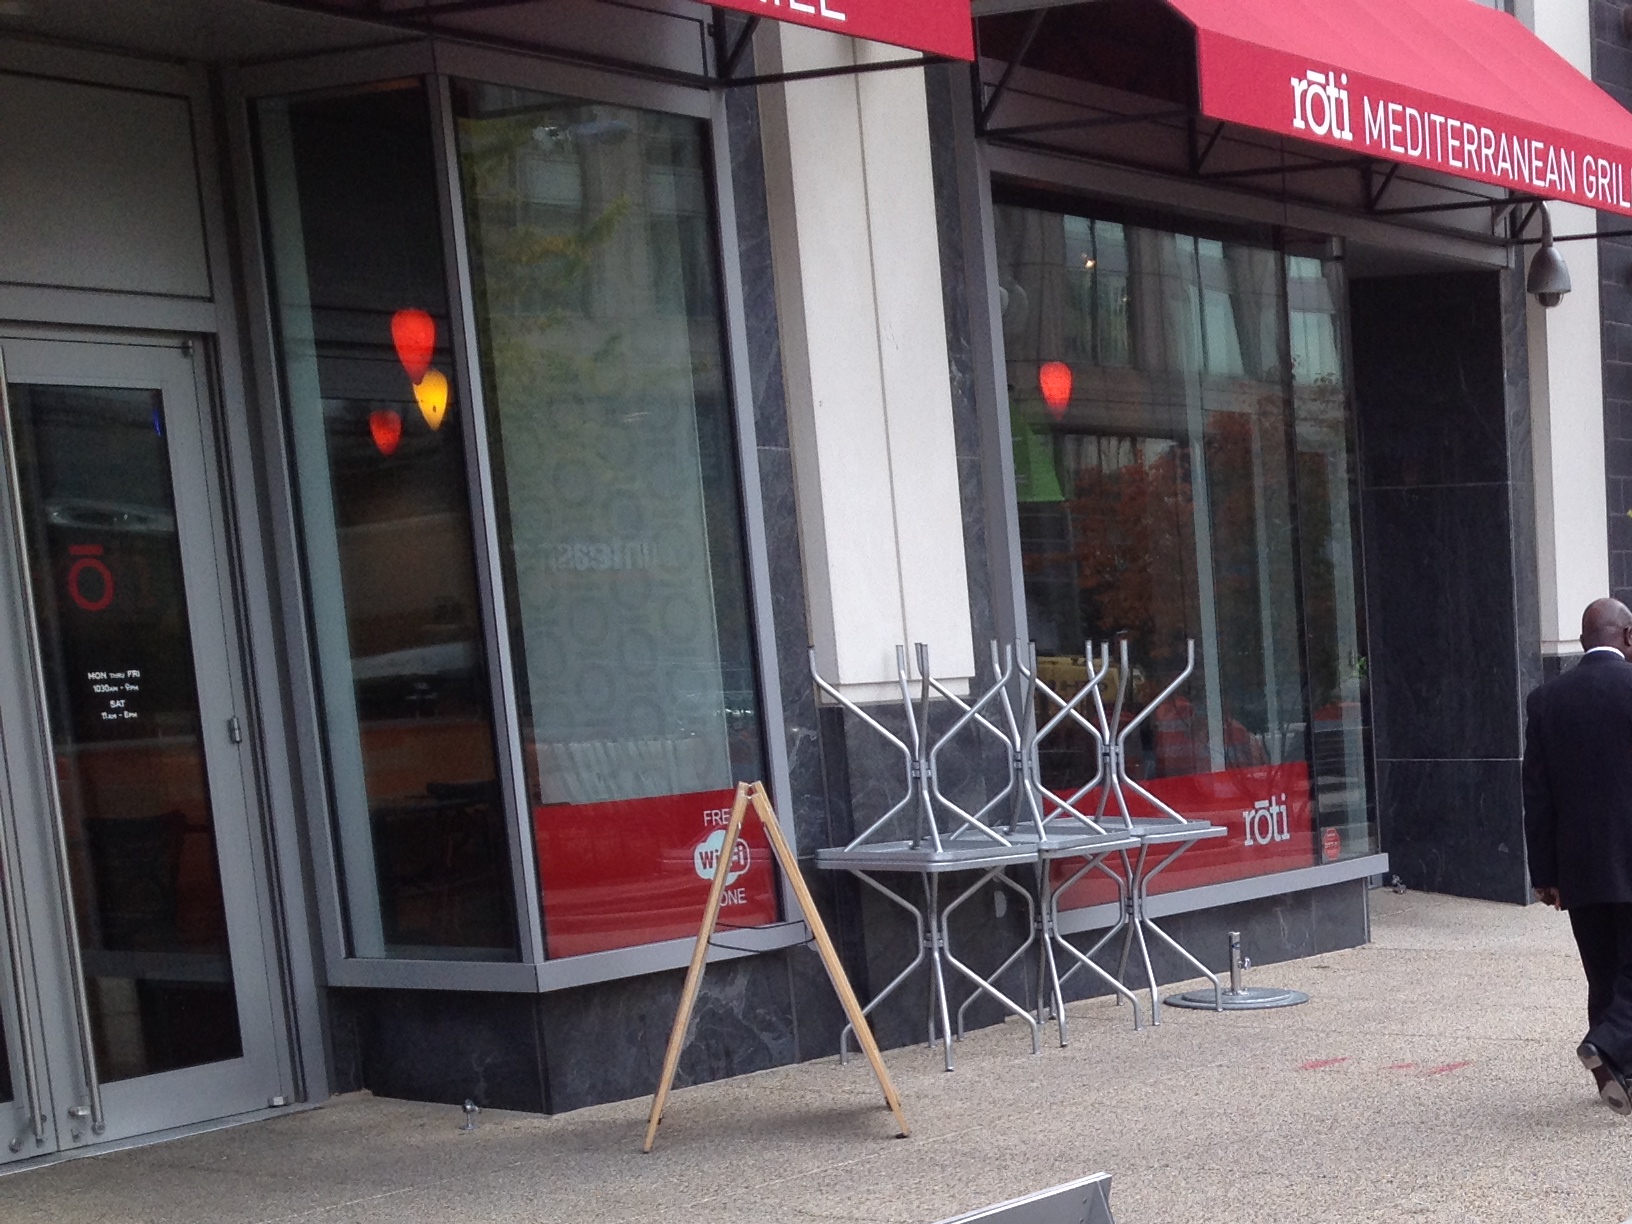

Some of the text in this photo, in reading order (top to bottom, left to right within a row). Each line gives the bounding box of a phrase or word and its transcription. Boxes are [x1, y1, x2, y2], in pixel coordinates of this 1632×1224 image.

[1363, 95, 1577, 194] MEDITERRANEAN
[88, 671, 107, 679] MON
[127, 670, 140, 678] FRI
[109, 699, 126, 708] SAT
[703, 808, 731, 826] FRE
[720, 888, 747, 906] ONE
